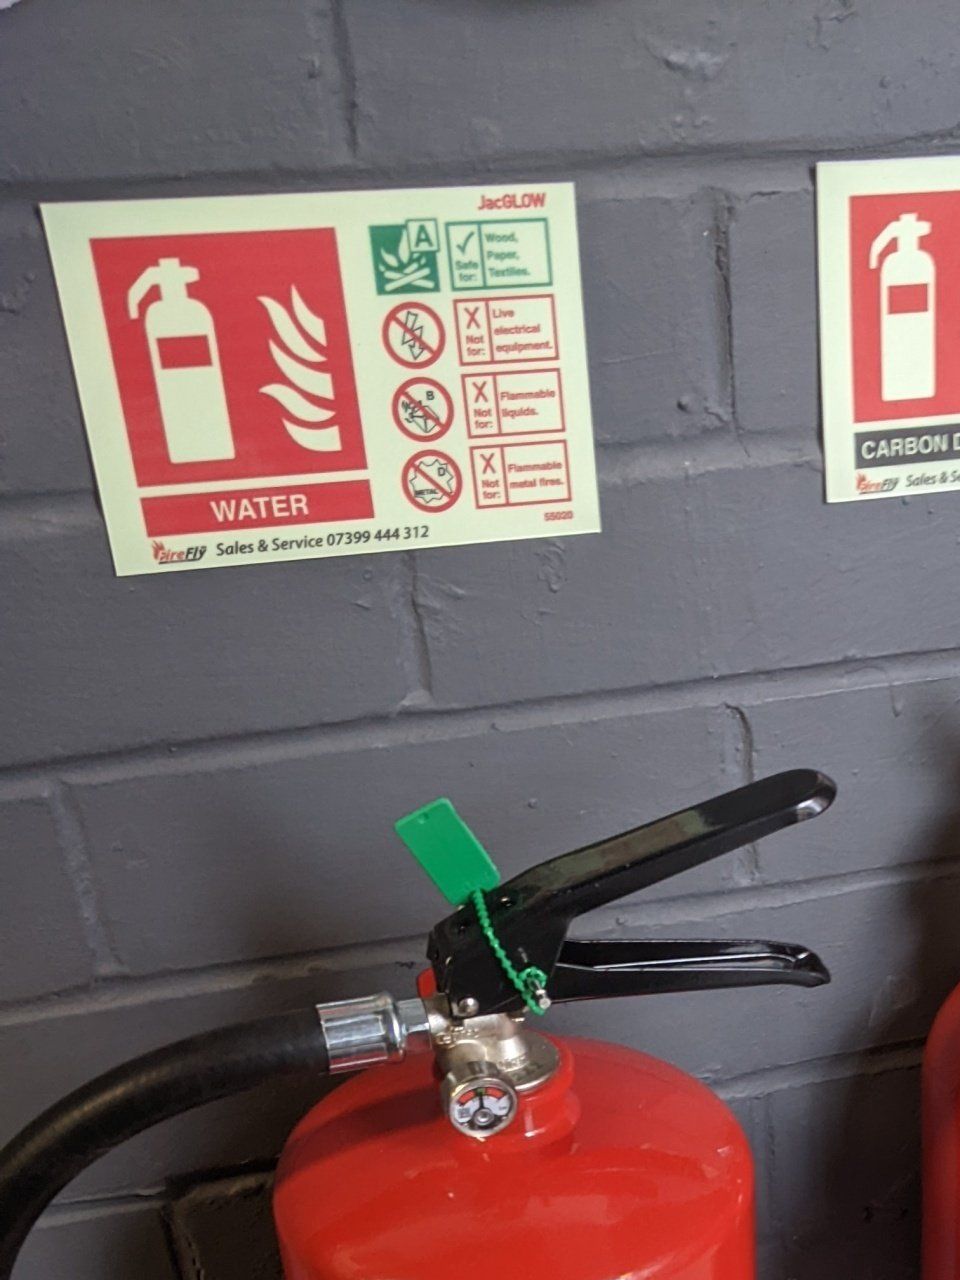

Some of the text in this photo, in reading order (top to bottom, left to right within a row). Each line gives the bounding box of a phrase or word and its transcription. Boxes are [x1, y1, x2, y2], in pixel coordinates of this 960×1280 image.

[477, 192, 546, 210] JacGLOW
[414, 224, 434, 248] A
[455, 261, 479, 271] Safe
[493, 308, 515, 319] Live
[494, 324, 540, 335] electrical
[466, 334, 484, 345] Not
[426, 390, 435, 401] B
[500, 389, 556, 401] Flammable
[474, 408, 492, 418] Not
[502, 407, 539, 419] liquids.
[861, 434, 948, 460] CARBON
[438, 466, 446, 477] D
[508, 461, 562, 473] Flammable
[482, 480, 500, 489] Not
[509, 478, 538, 490] metal
[905, 474, 937, 488] Sales
[940, 472, 948, 483] &
[209, 494, 309, 523] WATER
[216, 542, 254, 557] Sales
[257, 540, 269, 552] &
[272, 535, 323, 551] Service
[326, 532, 371, 547] 07399
[374, 528, 400, 541] 444
[403, 525, 430, 540] 312
